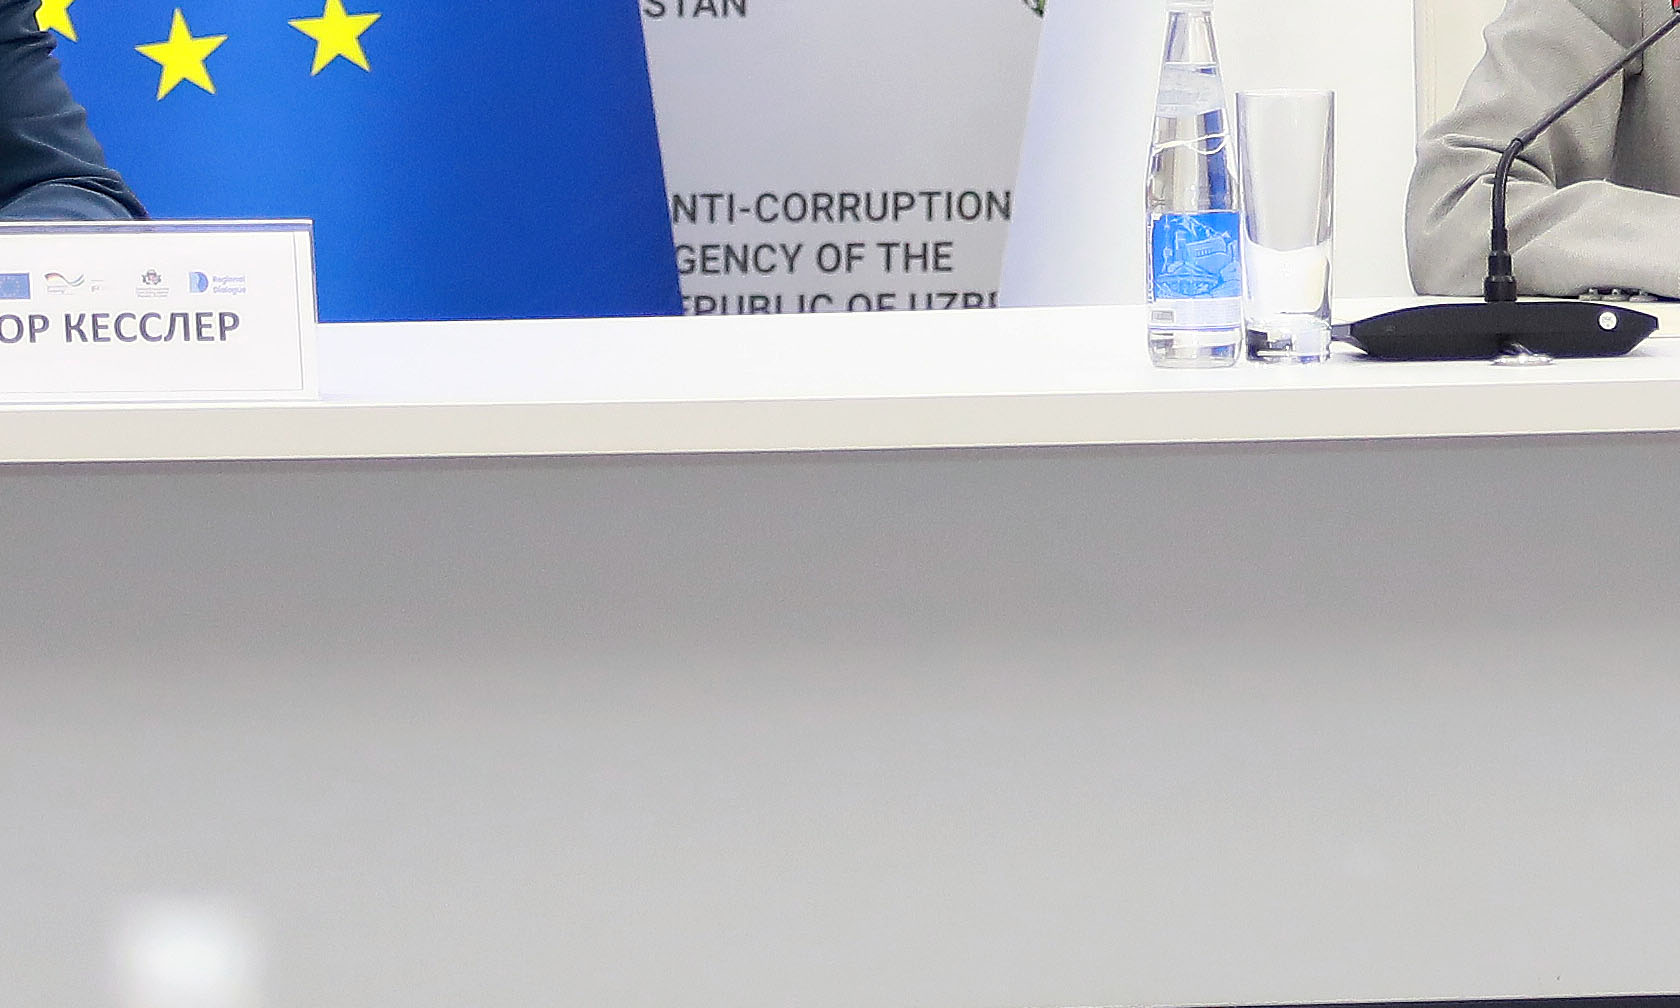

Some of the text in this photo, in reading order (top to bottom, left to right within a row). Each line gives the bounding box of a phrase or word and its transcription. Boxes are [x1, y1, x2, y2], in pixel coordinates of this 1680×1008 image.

[815, 241, 866, 275] OF
[875, 240, 954, 274] THE
[64, 311, 240, 343] КЕССЛЕР
